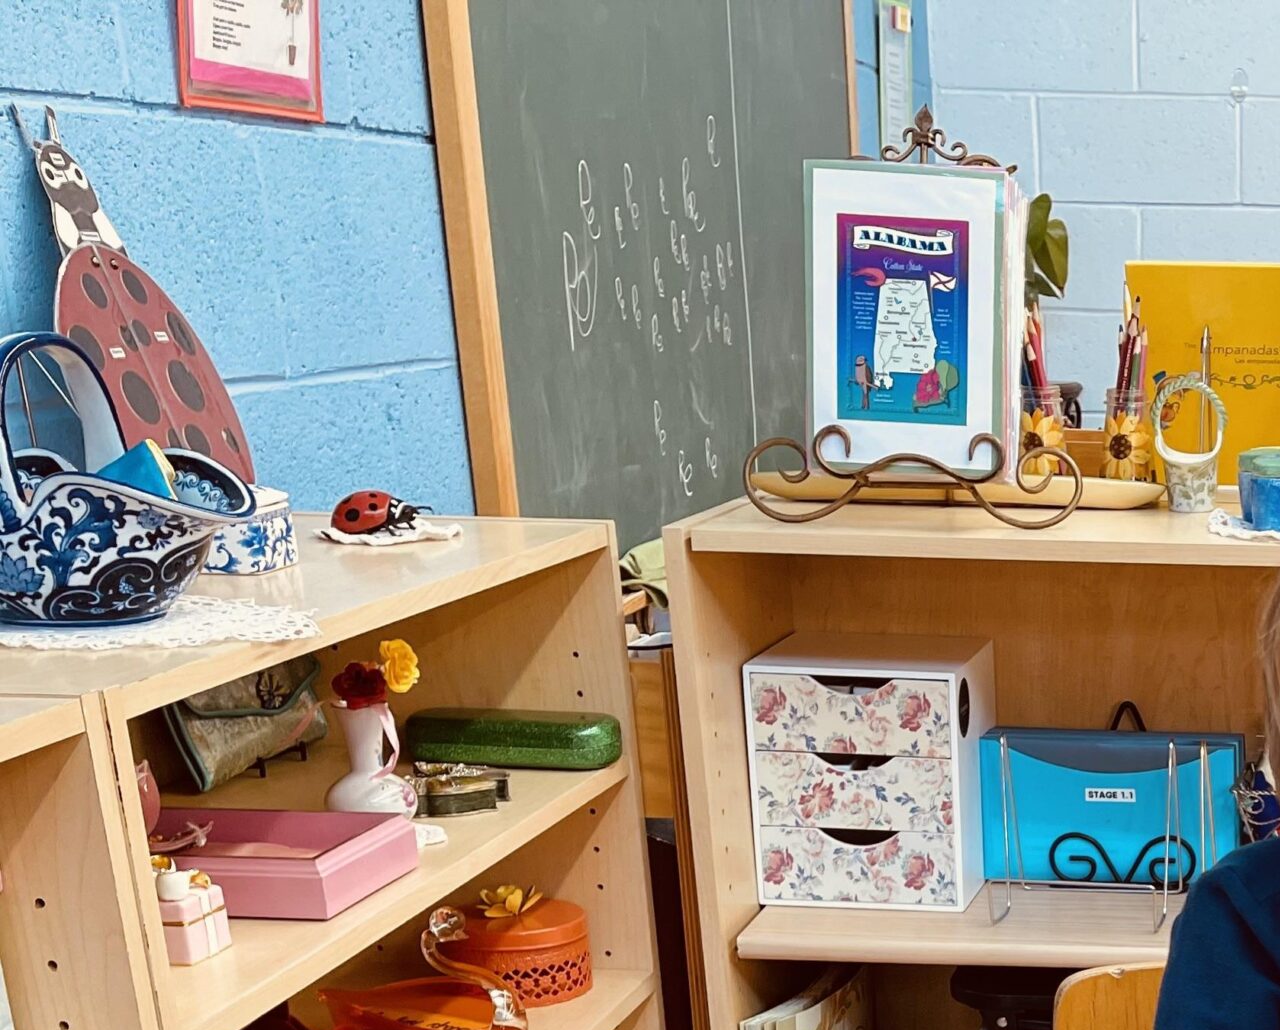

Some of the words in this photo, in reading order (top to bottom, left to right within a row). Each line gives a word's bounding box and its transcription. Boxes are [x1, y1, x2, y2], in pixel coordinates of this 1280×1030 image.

[860, 230, 947, 251] ALABAMA
[905, 259, 924, 273] State
[1088, 790, 1118, 799] STAGE
[1121, 791, 1133, 799] 1.1
